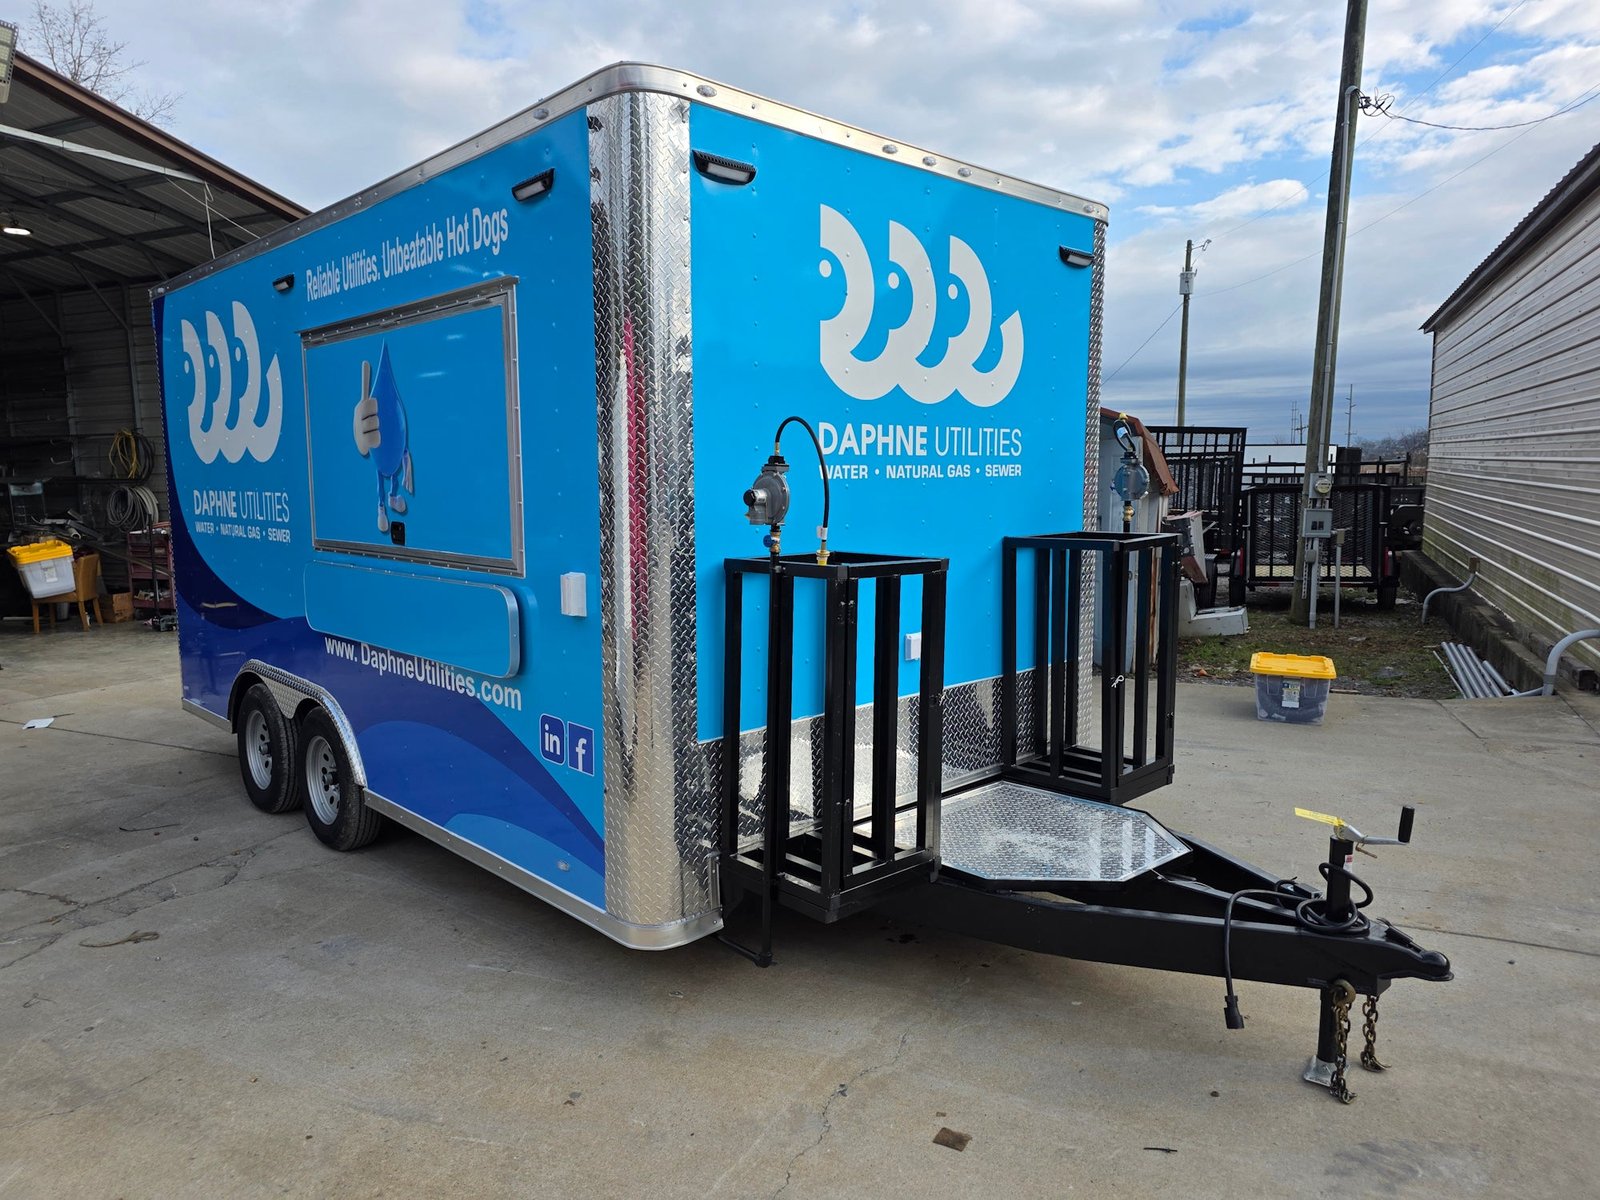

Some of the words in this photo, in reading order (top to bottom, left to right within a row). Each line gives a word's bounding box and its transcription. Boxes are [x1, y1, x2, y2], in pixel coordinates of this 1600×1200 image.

[306, 260, 341, 302] Reliable
[341, 248, 380, 291] Utilities.
[382, 222, 444, 278] Unbeatable
[446, 213, 470, 258] Hot
[472, 207, 508, 255] Dogs
[818, 421, 928, 456] DAPHNE
[935, 426, 1022, 457] UTILITIES
[819, 464, 868, 480] WATER
[886, 464, 944, 479] NATURAL
[947, 464, 971, 478] GAS
[985, 464, 1022, 478] SEWER
[193, 489, 237, 518] DAPHNE
[240, 490, 290, 523] UTILITIES
[195, 521, 215, 534] WATER
[220, 523, 247, 539] NATURAL
[247, 526, 261, 540] GAS
[267, 527, 291, 543] SEWER
[324, 636, 358, 662] www.
[361, 642, 522, 711] DaphneUtilities.com
[544, 723, 561, 756] in
